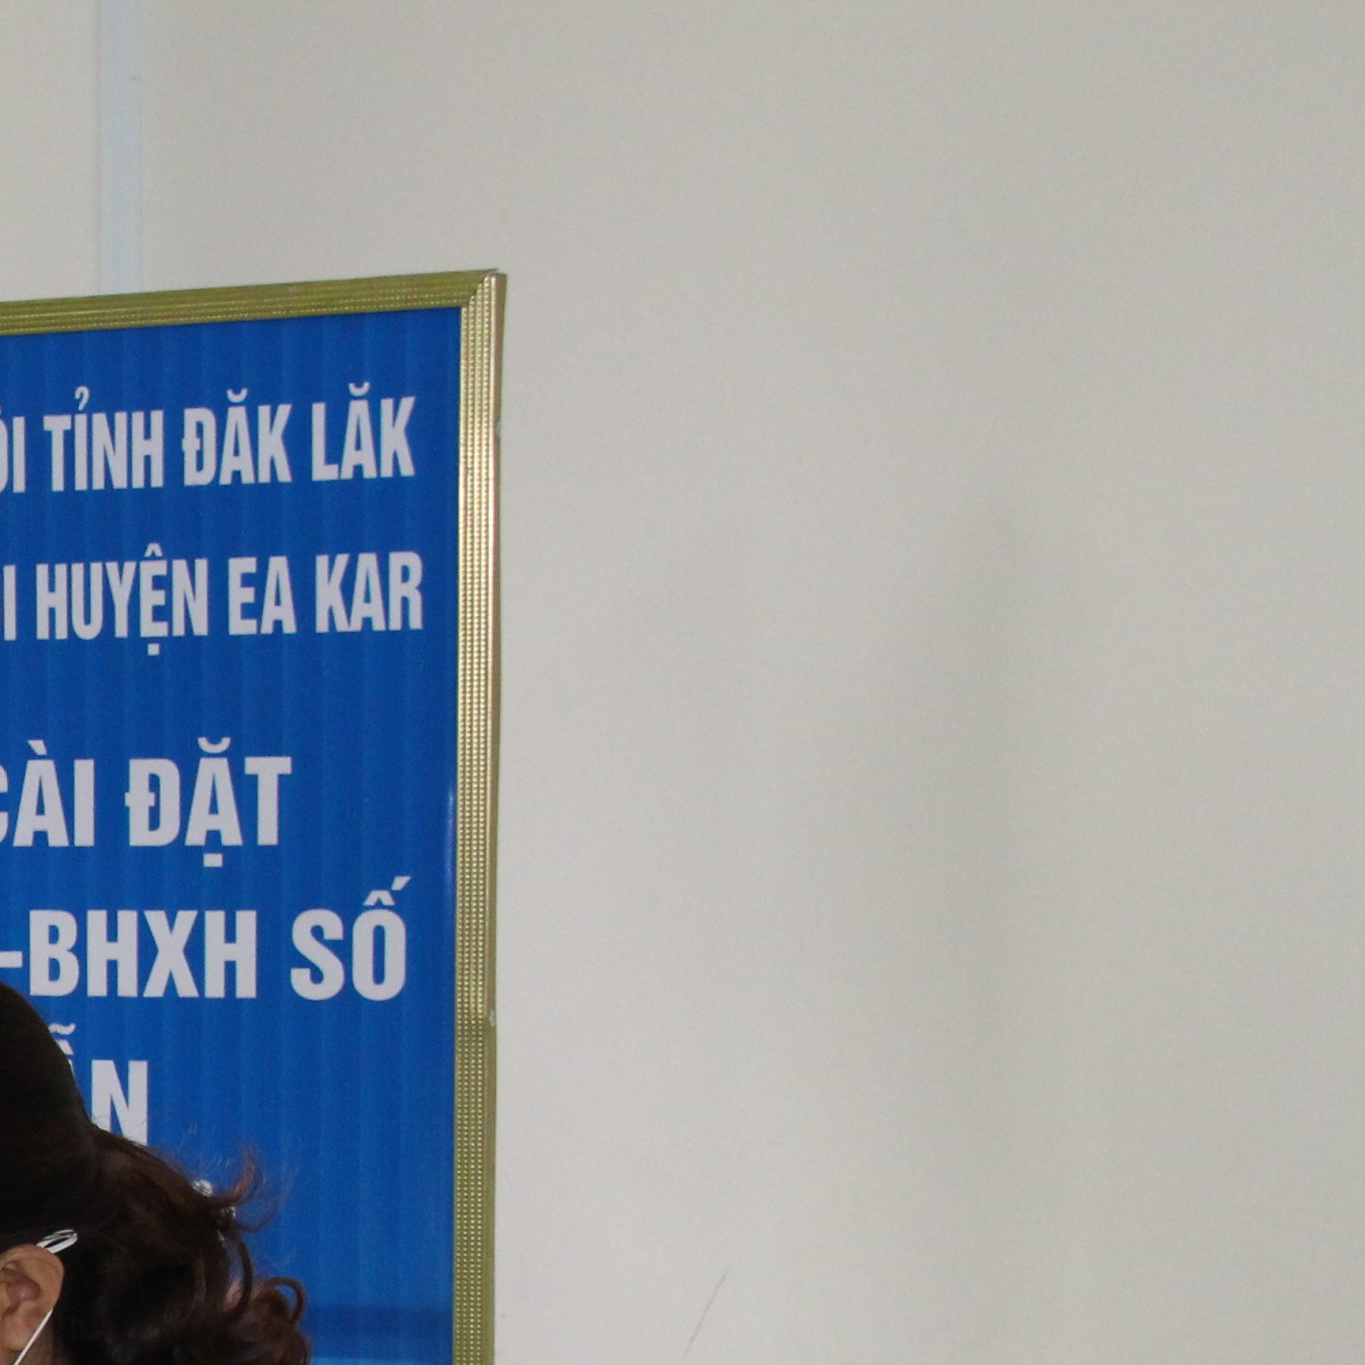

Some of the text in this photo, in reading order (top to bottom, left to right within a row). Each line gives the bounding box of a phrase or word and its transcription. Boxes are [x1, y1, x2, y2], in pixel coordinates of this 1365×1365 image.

[43, 386, 164, 491] TỈNH
[182, 388, 292, 486] ĐĂK
[312, 382, 415, 481] LĂK
[36, 543, 208, 655] HUYỆN
[229, 557, 297, 635] EA
[316, 551, 423, 633] KAR
[125, 737, 292, 867] ĐẶT
[290, 875, 411, 1001] SỐ
